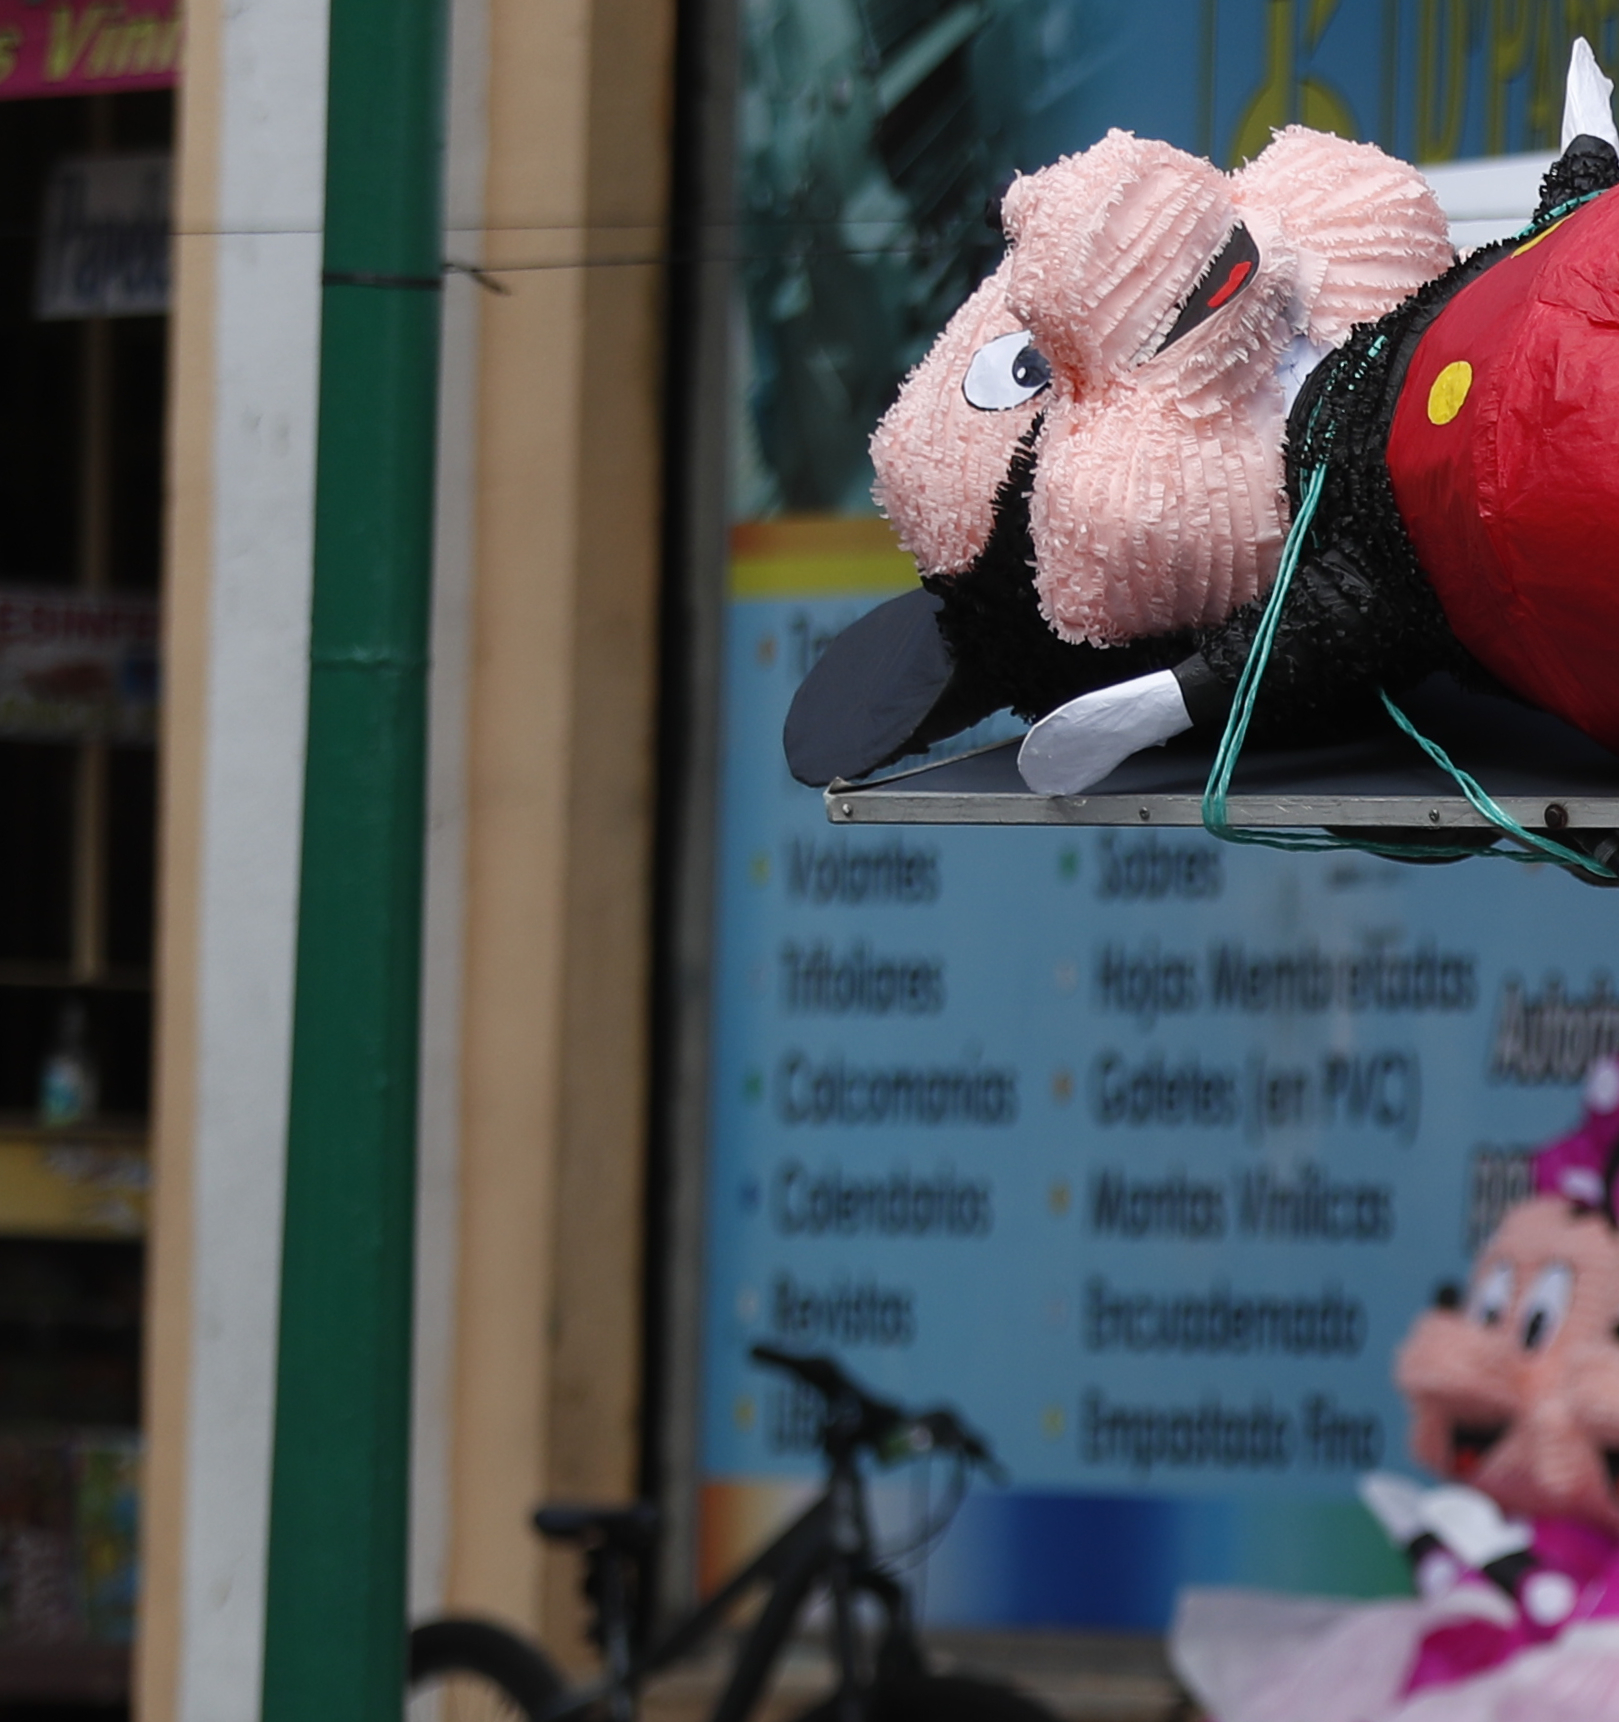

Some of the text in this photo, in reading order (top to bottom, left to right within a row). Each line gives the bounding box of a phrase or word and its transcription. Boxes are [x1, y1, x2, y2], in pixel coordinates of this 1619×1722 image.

[787, 840, 938, 904] Volantes
[1097, 946, 1201, 1027] Hojas
[774, 1160, 991, 1238] Calendarios
[1090, 1168, 1226, 1242] Mantas
[774, 1277, 917, 1347] Revistas
